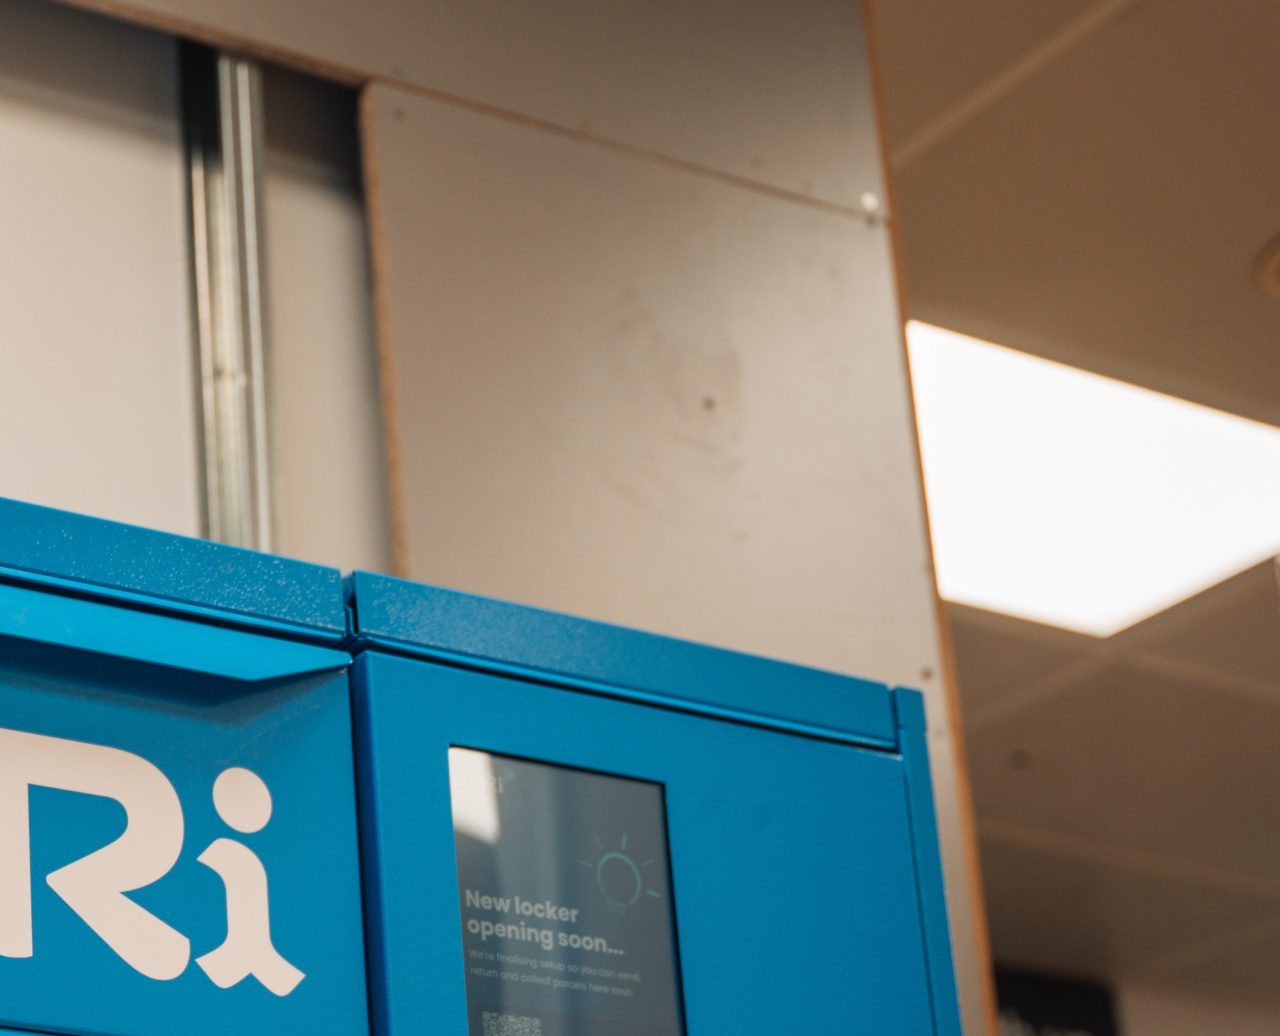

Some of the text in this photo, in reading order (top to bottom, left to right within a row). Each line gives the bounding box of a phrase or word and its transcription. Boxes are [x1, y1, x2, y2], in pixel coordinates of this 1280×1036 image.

[465, 889, 579, 923] New locker
[467, 919, 624, 955] opening soon...
